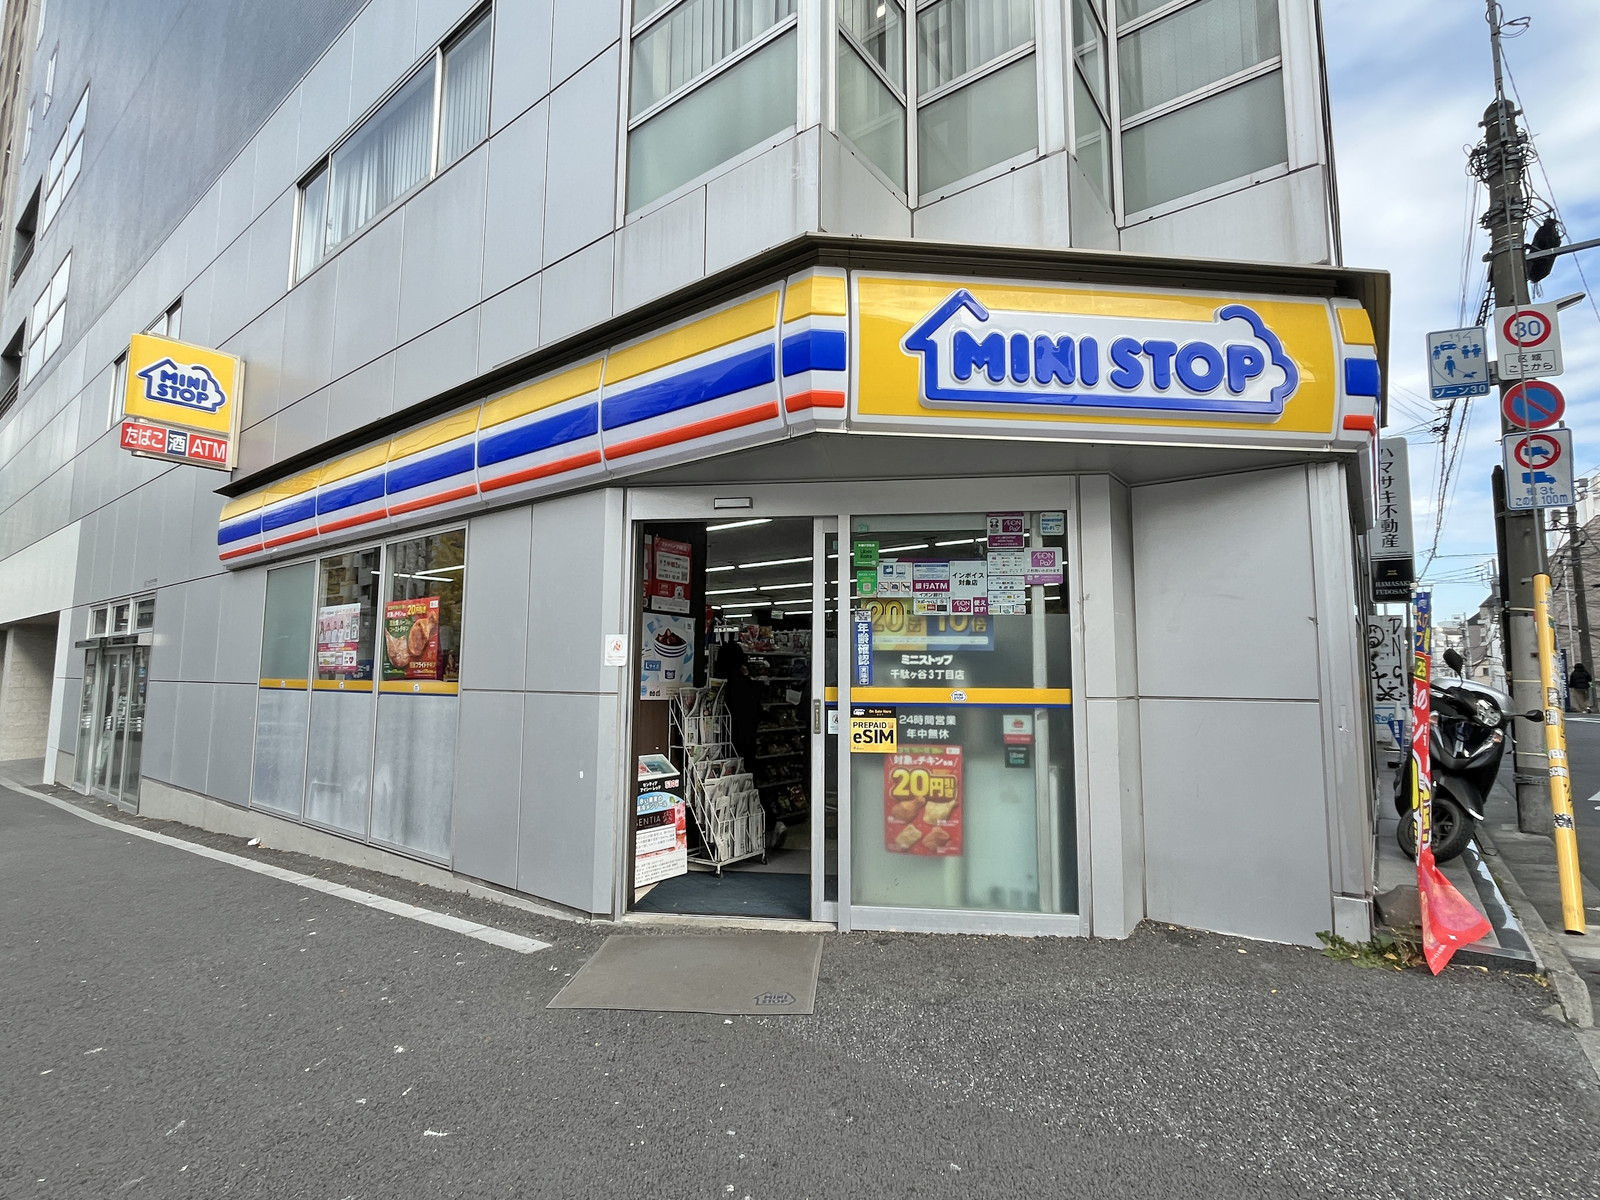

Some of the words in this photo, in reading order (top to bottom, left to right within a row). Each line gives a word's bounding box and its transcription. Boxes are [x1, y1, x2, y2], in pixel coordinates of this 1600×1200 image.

[1514, 320, 1541, 338] 30
[953, 330, 1098, 386] MINI
[1110, 337, 1265, 393] STOP
[1509, 362, 1553, 373] ここから
[160, 370, 208, 392] MINI
[157, 383, 209, 404] STOP
[125, 427, 164, 448] たばこ
[168, 434, 187, 452] 酒
[191, 440, 226, 460] ATM
[1380, 448, 1399, 549] ハマサキ不動産
[858, 623, 869, 666] 年齢確認
[901, 654, 954, 665] ミニストップ
[890, 669, 965, 680] 千駄ヶ谷3丁目店
[899, 715, 956, 726] 24時間営業
[853, 729, 894, 744] eSIM
[906, 729, 950, 740] 年中無休
